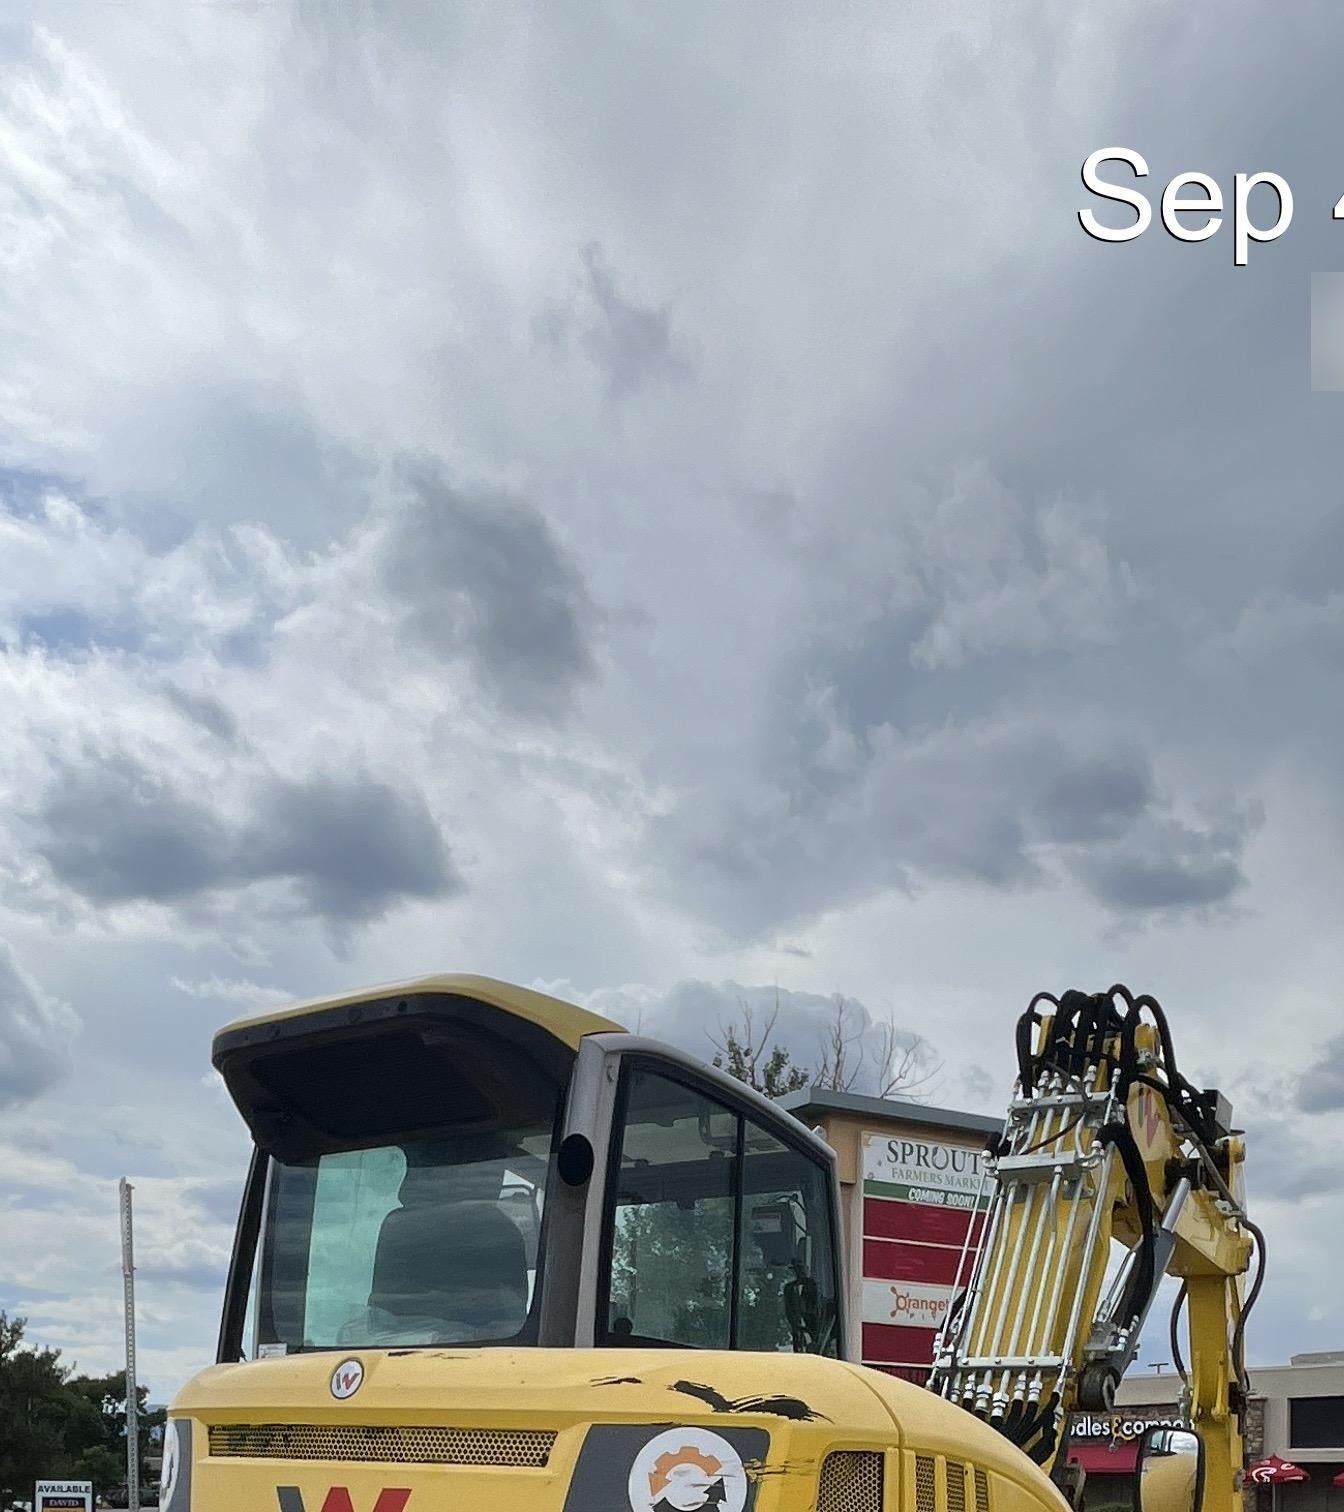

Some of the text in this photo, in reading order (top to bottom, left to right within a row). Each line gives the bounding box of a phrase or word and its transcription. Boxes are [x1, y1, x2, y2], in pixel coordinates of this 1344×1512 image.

[886, 1140, 980, 1175] SPROUT
[891, 1168, 989, 1191] FARMERS MARKT
[908, 1187, 945, 1204] COMING
[1070, 1416, 1110, 1437] dles
[37, 1485, 91, 1493] AVAILABLE
[49, 1499, 79, 1507] DAVID
